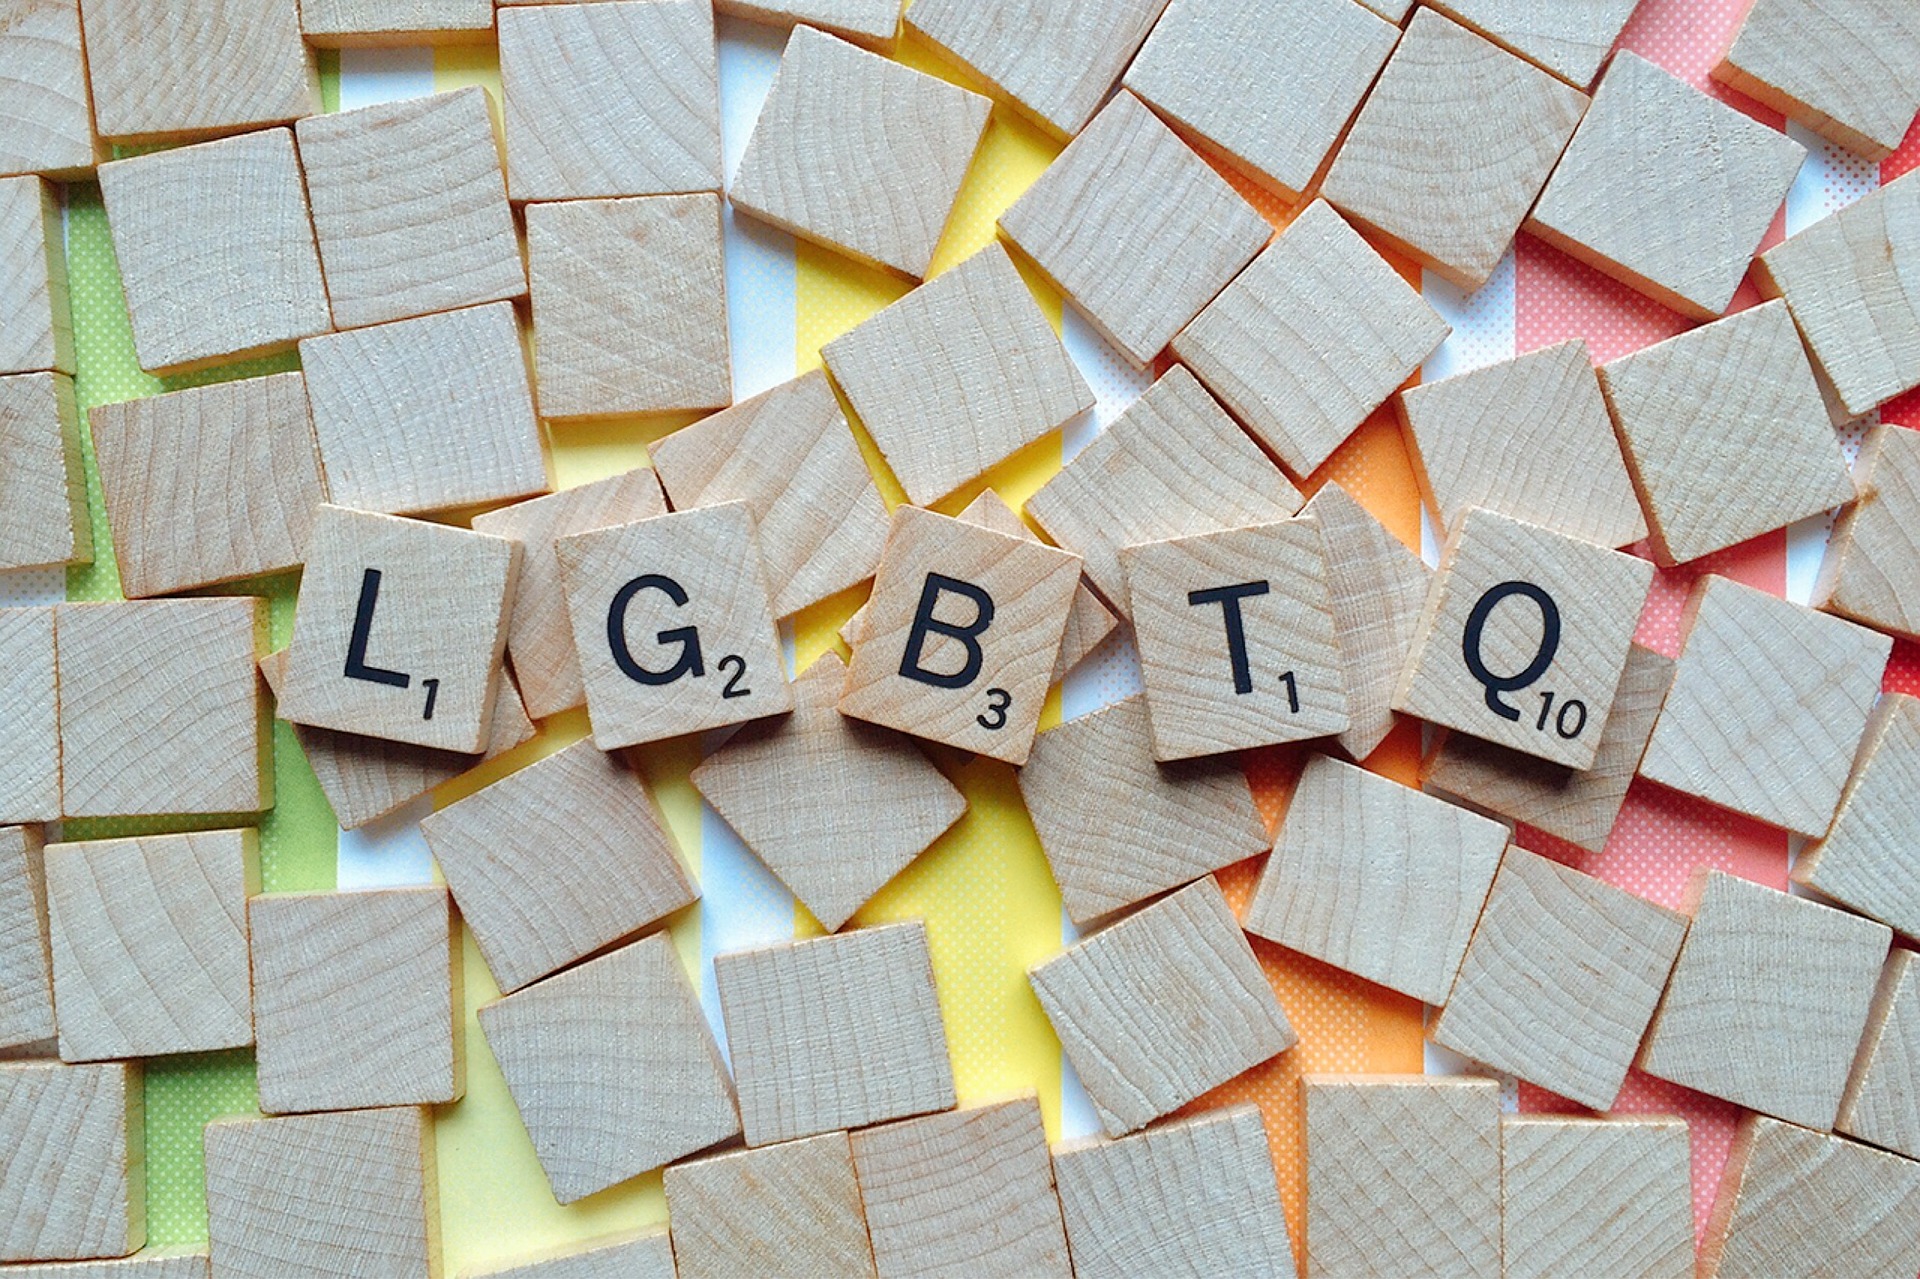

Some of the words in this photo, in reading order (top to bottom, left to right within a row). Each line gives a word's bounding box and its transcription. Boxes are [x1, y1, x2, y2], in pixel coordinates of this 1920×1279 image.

[717, 654, 752, 700] 2
[1278, 670, 1301, 714] 1
[421, 678, 441, 721] 1
[976, 687, 1012, 731] 3
[1536, 691, 1588, 740] 10
